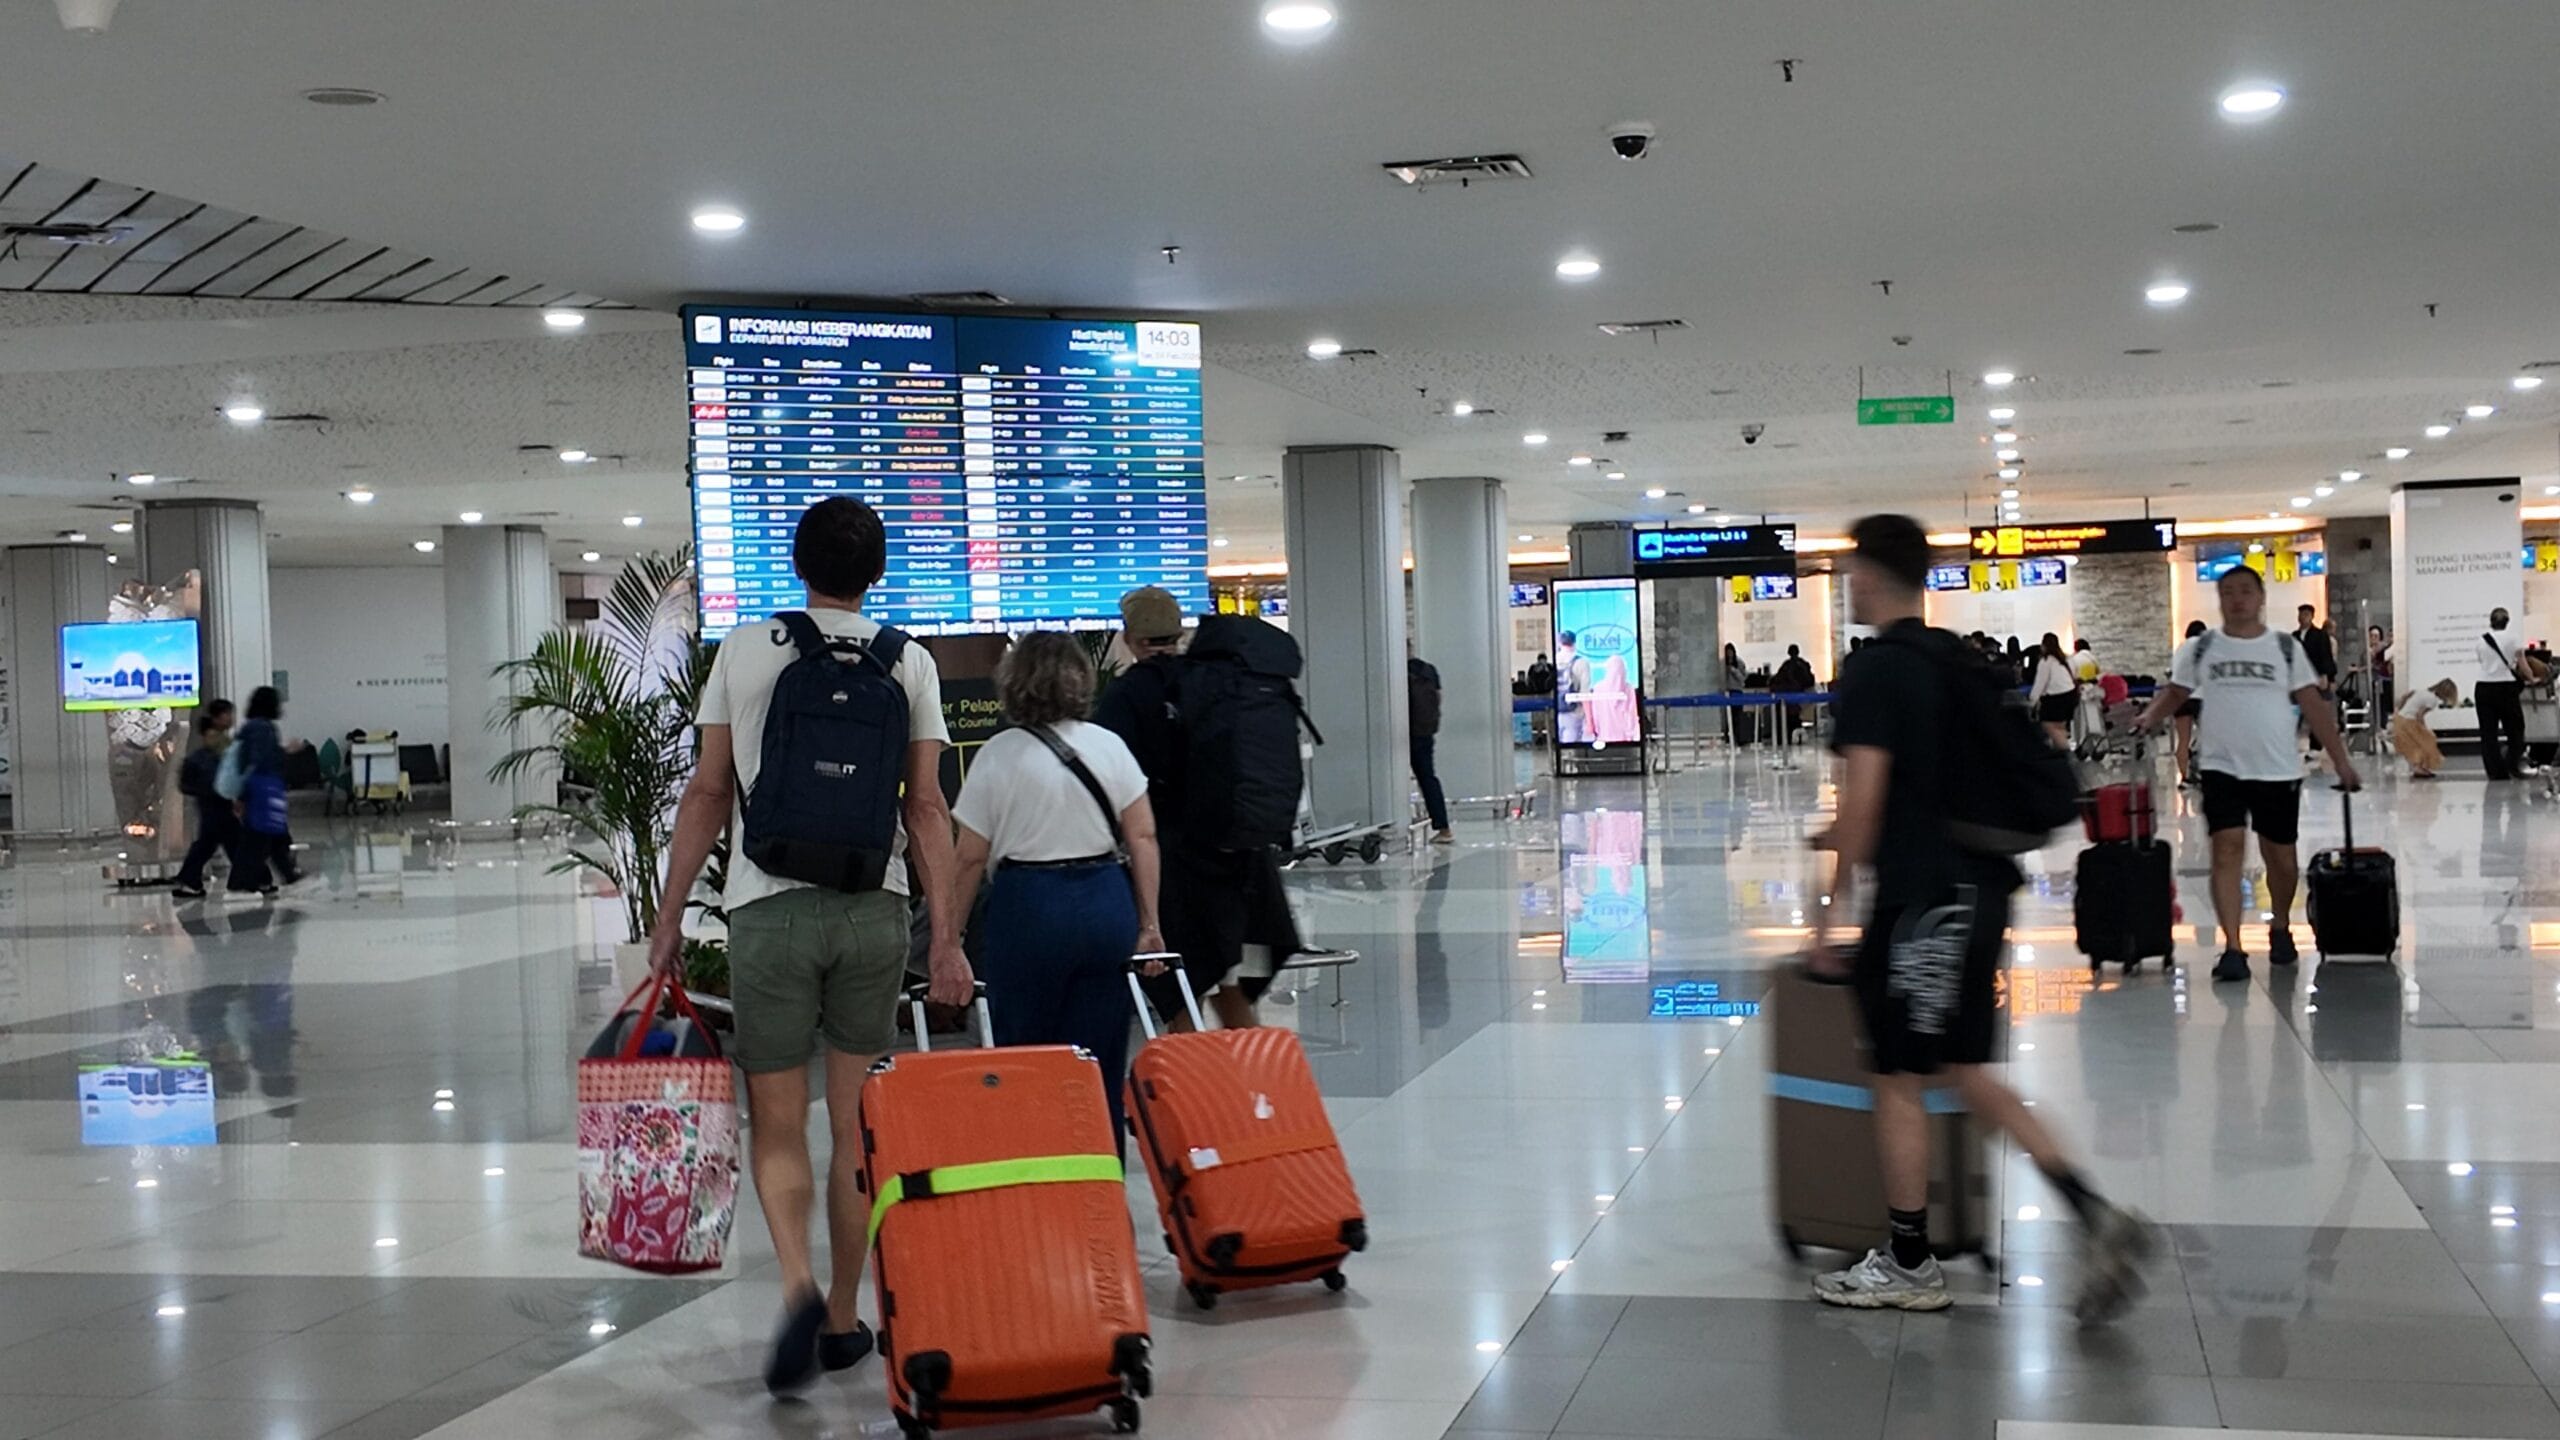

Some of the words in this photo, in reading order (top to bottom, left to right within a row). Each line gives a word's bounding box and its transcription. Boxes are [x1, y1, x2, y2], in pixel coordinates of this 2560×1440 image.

[729, 318, 809, 334] INFORMASI
[810, 321, 932, 339] KEBERANGKATAN
[1147, 330, 1190, 347] 14:03
[2541, 558, 2557, 572] 34
[1584, 633, 1621, 648] Pixel
[2209, 660, 2275, 681] NIKE
[958, 717, 998, 728] Counter
